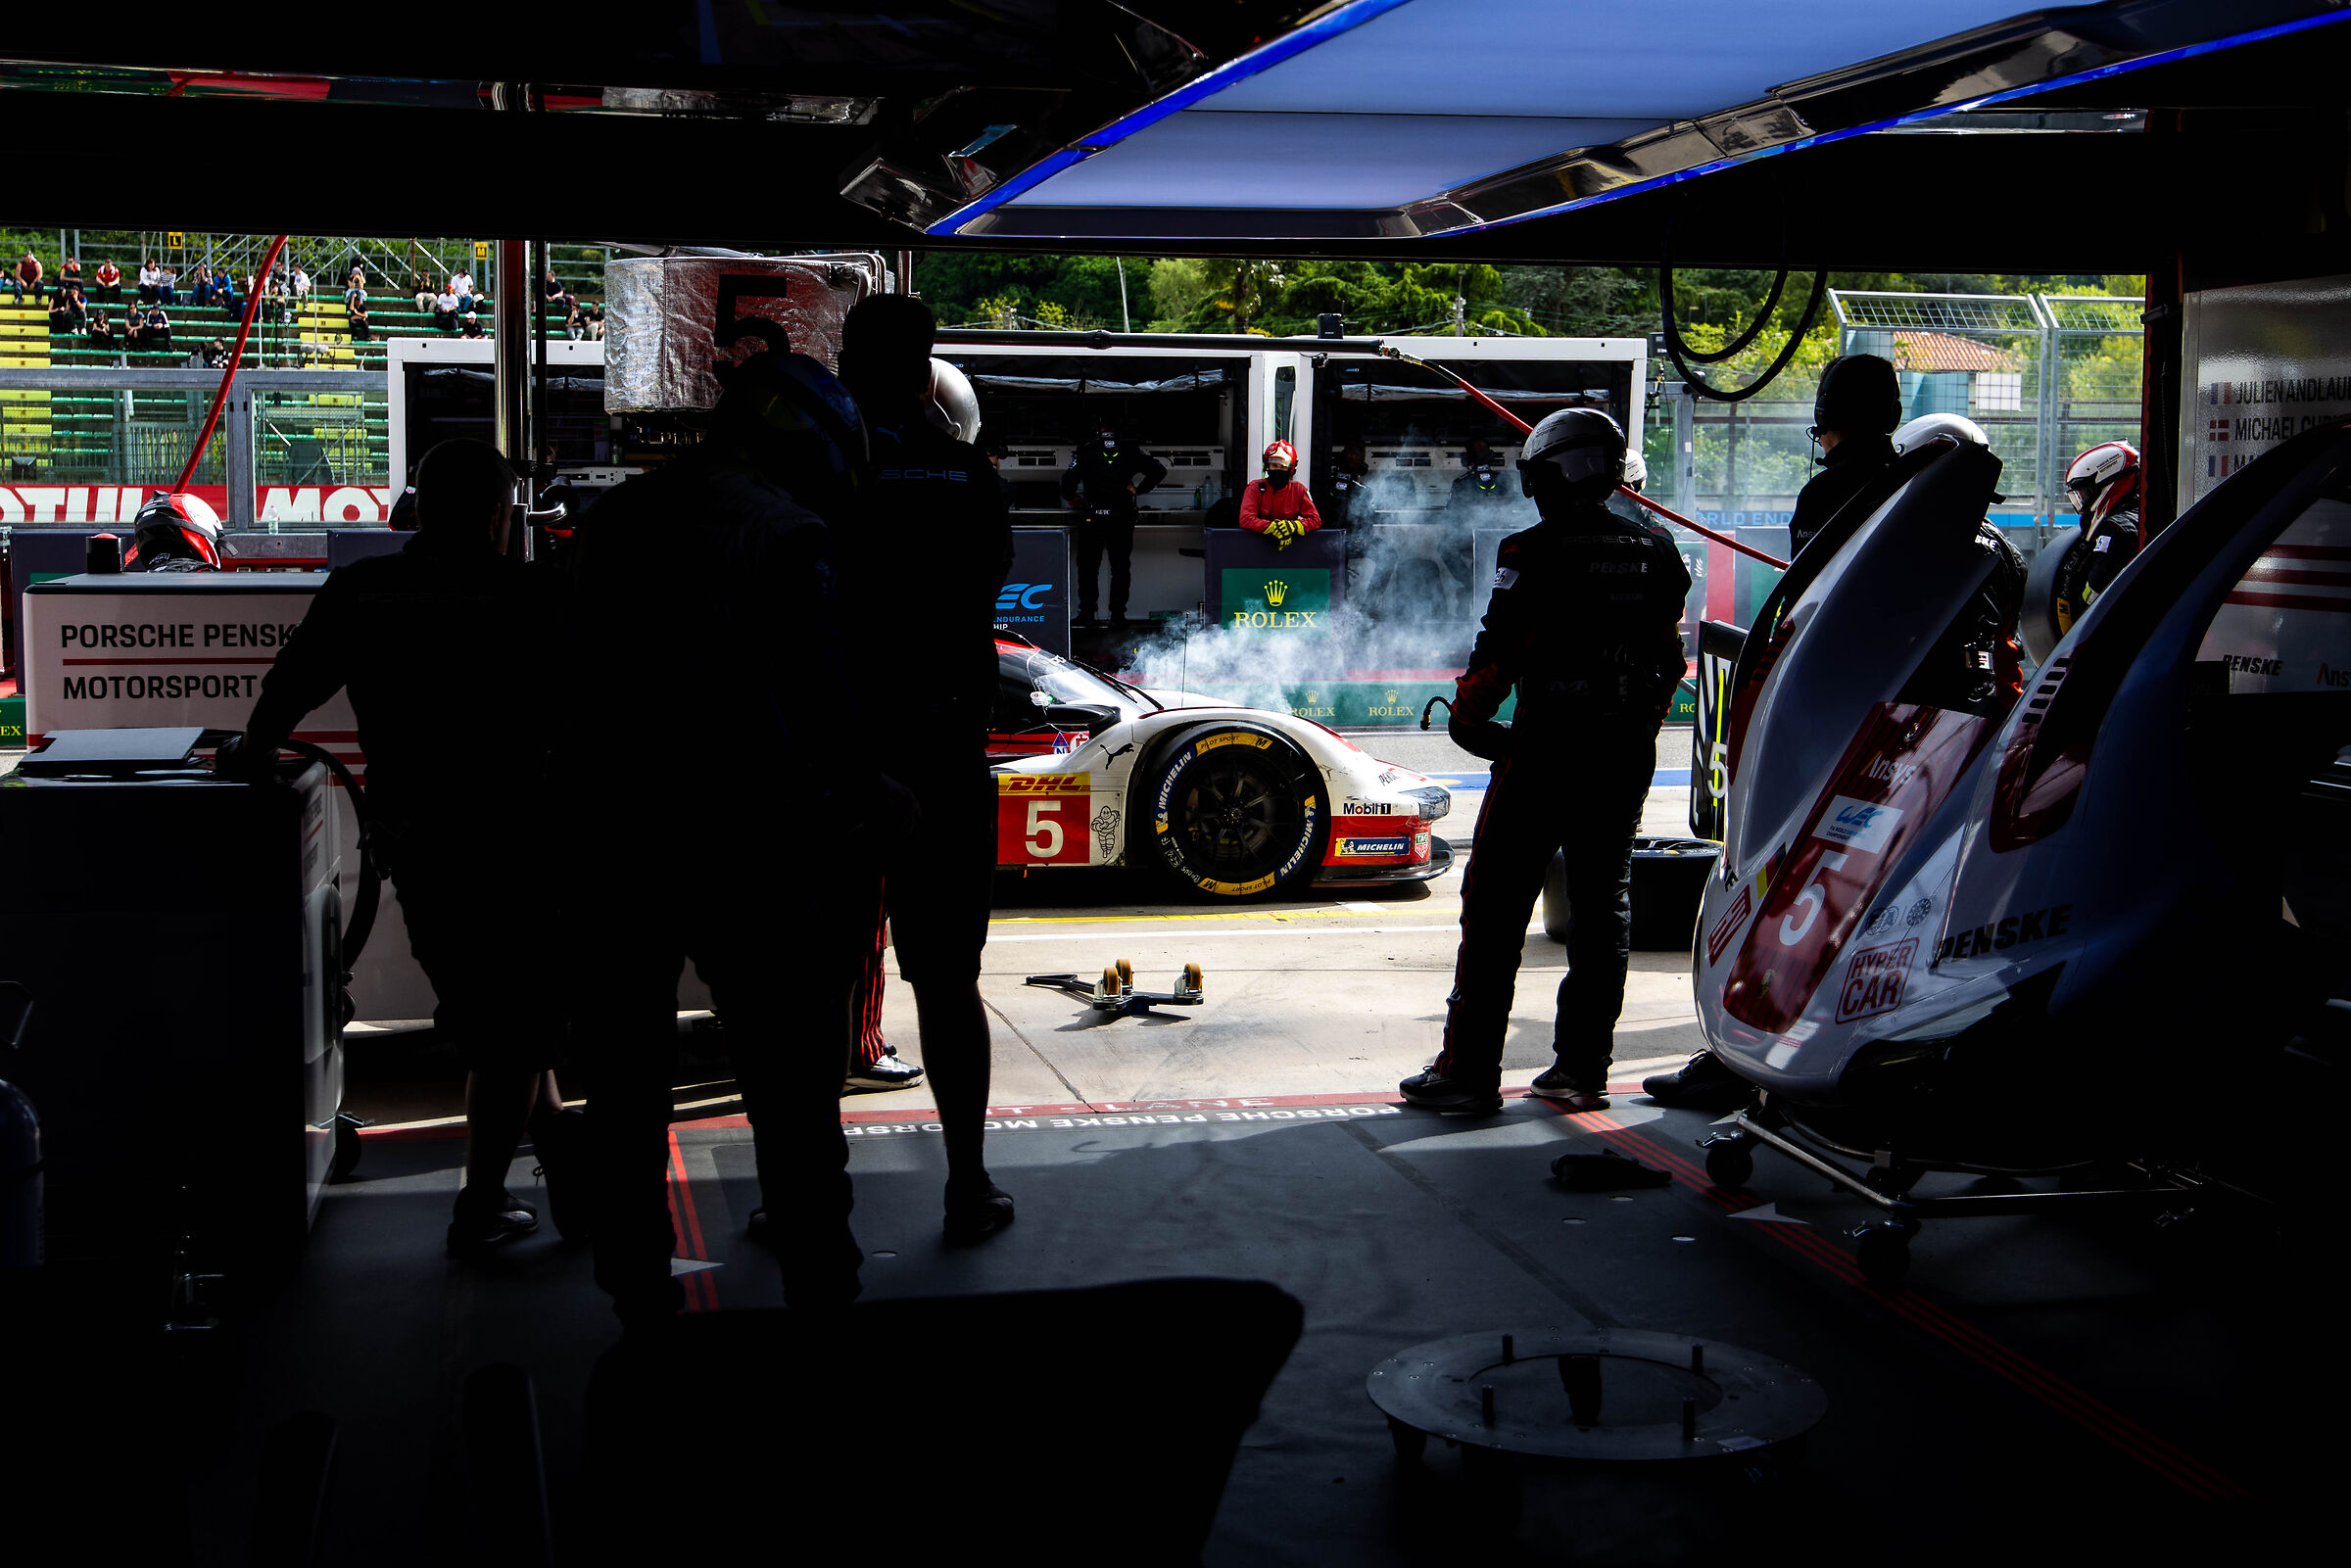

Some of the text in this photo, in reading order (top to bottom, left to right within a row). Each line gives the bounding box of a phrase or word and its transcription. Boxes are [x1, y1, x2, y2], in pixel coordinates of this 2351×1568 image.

[711, 274, 792, 384] 5
[2235, 380, 2283, 404] JULIEN
[879, 469, 968, 482] SCHE
[262, 487, 390, 522] MO
[995, 583, 1053, 610] EC
[993, 615, 1045, 624] NDURANCE
[1233, 611, 1318, 629] ROLEX
[61, 624, 296, 647] PORSCHE PENSK
[64, 675, 257, 699] MOTORSPORT
[1368, 706, 1415, 717] ROLEX
[1007, 776, 1080, 791] DHL
[1158, 751, 1192, 810] MICHELIN
[1343, 803, 1378, 815] Mobil
[1835, 805, 1884, 829] WEC
[1025, 800, 1064, 858] 5
[1279, 819, 1314, 878] MICHELIN
[1356, 842, 1405, 851] MICHELIN
[1778, 849, 1848, 946] 5
[1930, 904, 2072, 970] PENSKE
[1850, 945, 1911, 979] HYPER
[1843, 973, 1903, 1017] CAR
[1049, 1115, 1207, 1128] PENSKE
[1218, 1107, 1402, 1121] PORSCHE
